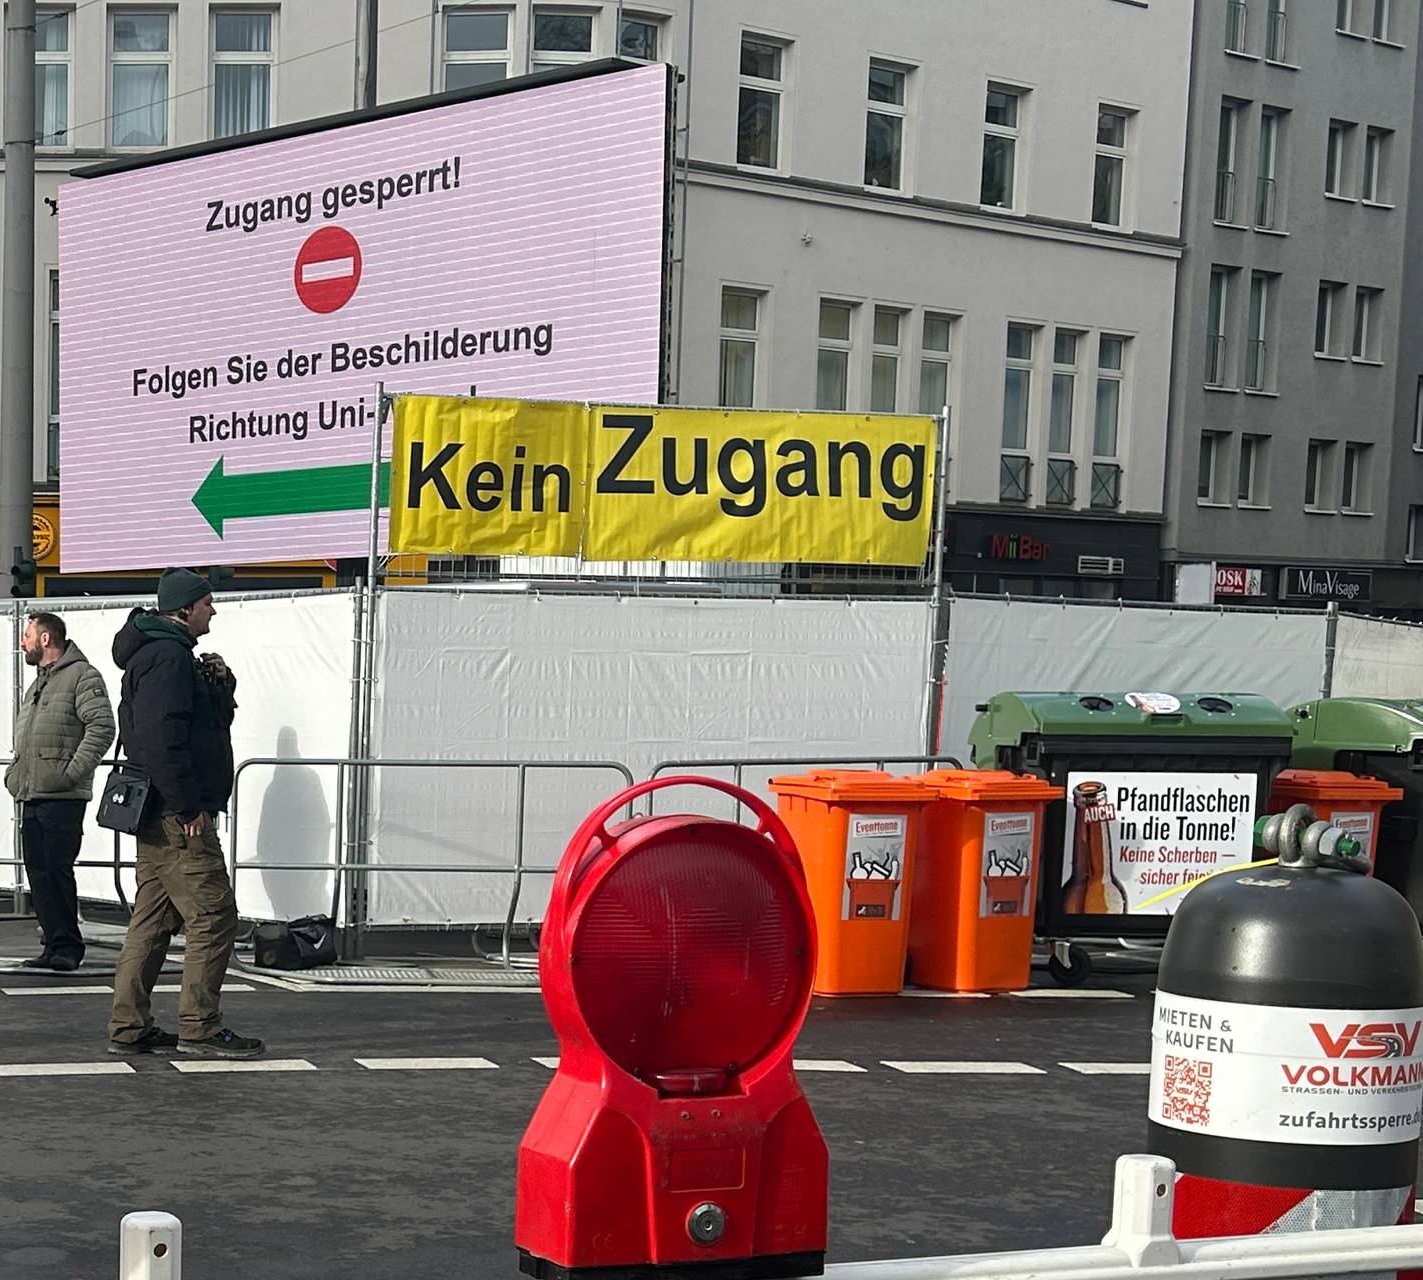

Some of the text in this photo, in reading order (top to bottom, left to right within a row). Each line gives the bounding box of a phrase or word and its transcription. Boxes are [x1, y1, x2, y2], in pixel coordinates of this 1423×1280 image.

[206, 156, 461, 232] Zugang gesperrt!
[133, 323, 553, 399] Folgen Sie der Beschilderung
[189, 398, 393, 443] Richtung Uni-
[407, 415, 926, 521] Kein Zugang
[1217, 569, 1244, 586] OSK
[1116, 787, 1250, 813] Pfandflaschen
[1083, 806, 1115, 822] AUCH
[1119, 816, 1236, 841] in die Tonne!
[1120, 846, 1155, 863] Keine
[1158, 846, 1217, 863] Scherben
[1140, 869, 1180, 885] sicher
[1159, 1007, 1232, 1032] MIETEN &
[1166, 1030, 1234, 1054] KAUFEN
[1308, 1020, 1422, 1059] VSV
